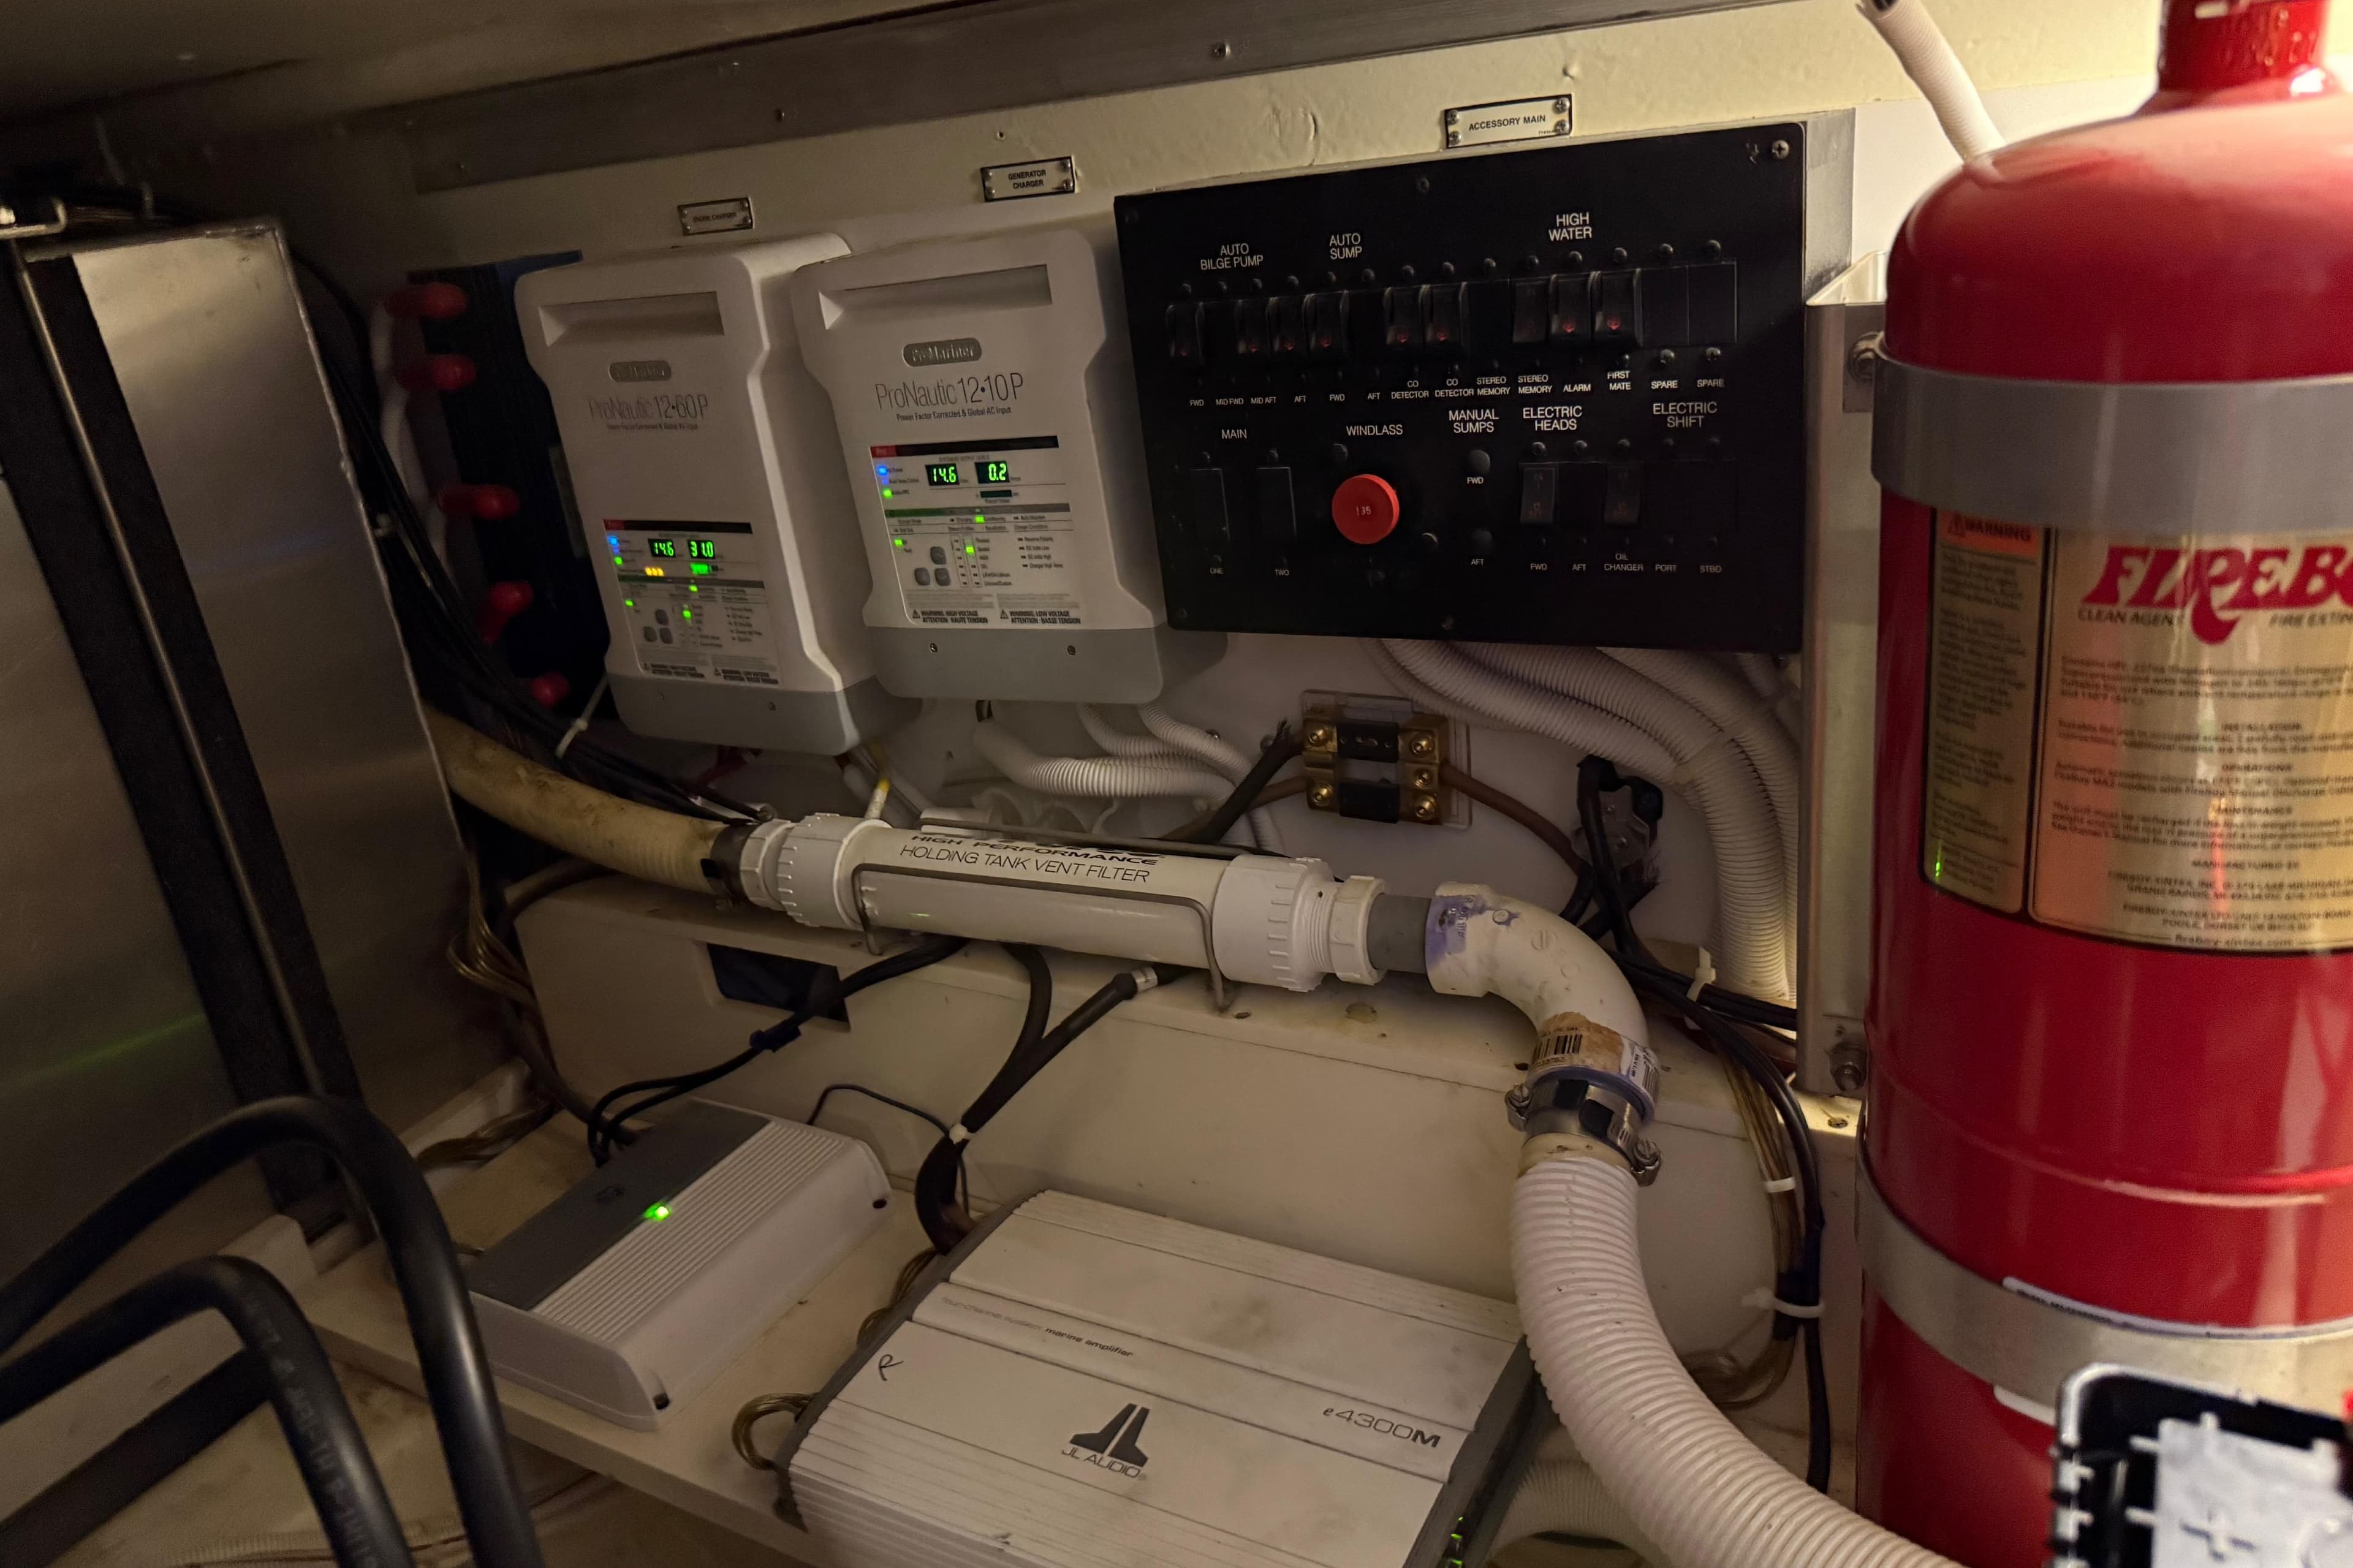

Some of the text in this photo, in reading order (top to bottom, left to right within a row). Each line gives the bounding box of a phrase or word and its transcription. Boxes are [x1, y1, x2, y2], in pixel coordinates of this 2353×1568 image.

[1469, 115, 1546, 131] ACCESSORY MAIN
[1008, 169, 1047, 180] GENERATOR
[1013, 180, 1044, 189] CHARGER
[1556, 212, 1590, 227] HIGH
[1330, 233, 1361, 246] AUTO
[1548, 226, 1593, 242] WATER
[1220, 243, 1249, 256] AUTO
[1330, 247, 1362, 260] SUMP
[1200, 255, 1264, 270] BILGE PUMP
[1476, 376, 1507, 385] STEREO
[1518, 374, 1548, 384] STEREO
[1607, 370, 1631, 380] FIRST
[1563, 383, 1591, 393] ALARM
[1609, 381, 1632, 391] MATE
[1651, 379, 1679, 390] SPARE
[1697, 377, 1724, 388] SPARE
[875, 377, 957, 410] ProNautic
[1391, 390, 1429, 400] DETECTOR
[1434, 387, 1474, 398] DETECTOR
[1477, 386, 1511, 396] MEMORY
[1518, 384, 1553, 395] MEMORY
[1329, 393, 1345, 402] FWD
[915, 412, 932, 420] Factor
[933, 410, 961, 419] Corrected
[987, 406, 995, 415] AC
[1523, 406, 1583, 420] ELECTRIC
[1653, 401, 1718, 415] ELECTRIC
[1449, 409, 1499, 422] MANUAL
[1667, 414, 1705, 428] SHIFT
[1346, 424, 1403, 436] WINDLASS
[1453, 422, 1495, 434] SUMPS
[1534, 419, 1578, 431] HEADS
[1221, 429, 1248, 439] MAIN
[933, 463, 1007, 483] 14.6 0.2
[653, 541, 675, 556] 14.6
[1604, 563, 1644, 572] CHANGER
[1655, 564, 1677, 573] PORT
[1700, 565, 1722, 574] STBD
[911, 835, 1159, 866] HIGH PERFORMANCE
[900, 845, 1151, 883] HOLDING TANK VENT FILTER
[1045, 1327, 1083, 1343] marine
[1085, 1339, 1134, 1357] amplifier
[1323, 1408, 1441, 1448] e4300M
[1061, 1447, 1082, 1460] JL
